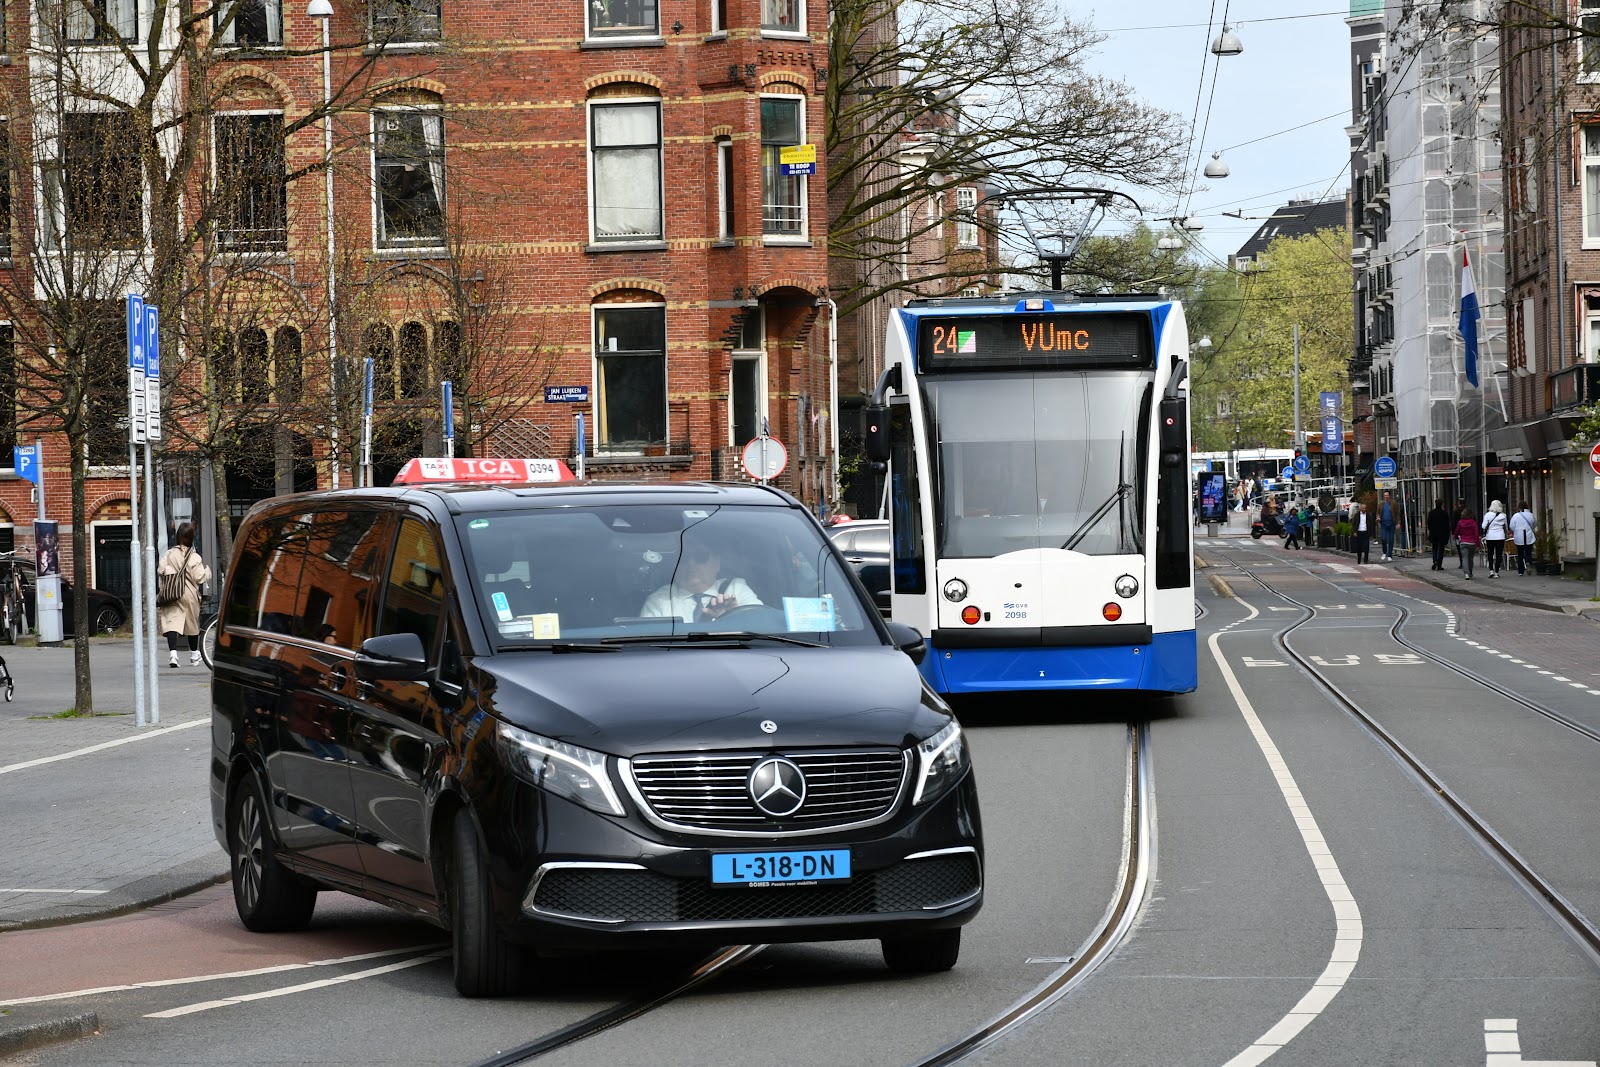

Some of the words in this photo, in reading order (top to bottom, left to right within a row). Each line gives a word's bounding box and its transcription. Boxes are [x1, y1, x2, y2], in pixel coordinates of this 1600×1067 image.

[134, 301, 141, 337] P
[149, 312, 156, 348] P
[933, 326, 958, 354] 24
[1021, 322, 1089, 351] VUmc
[561, 387, 582, 395] LUIJKEN
[1326, 397, 1337, 418] AT
[1326, 420, 1337, 440] BLUE
[20, 456, 30, 472] P
[424, 462, 449, 470] TAXI
[462, 460, 516, 474] TCA
[529, 463, 554, 474] 0394
[1004, 611, 1027, 619] 2098
[732, 854, 835, 879] L-318-DN
